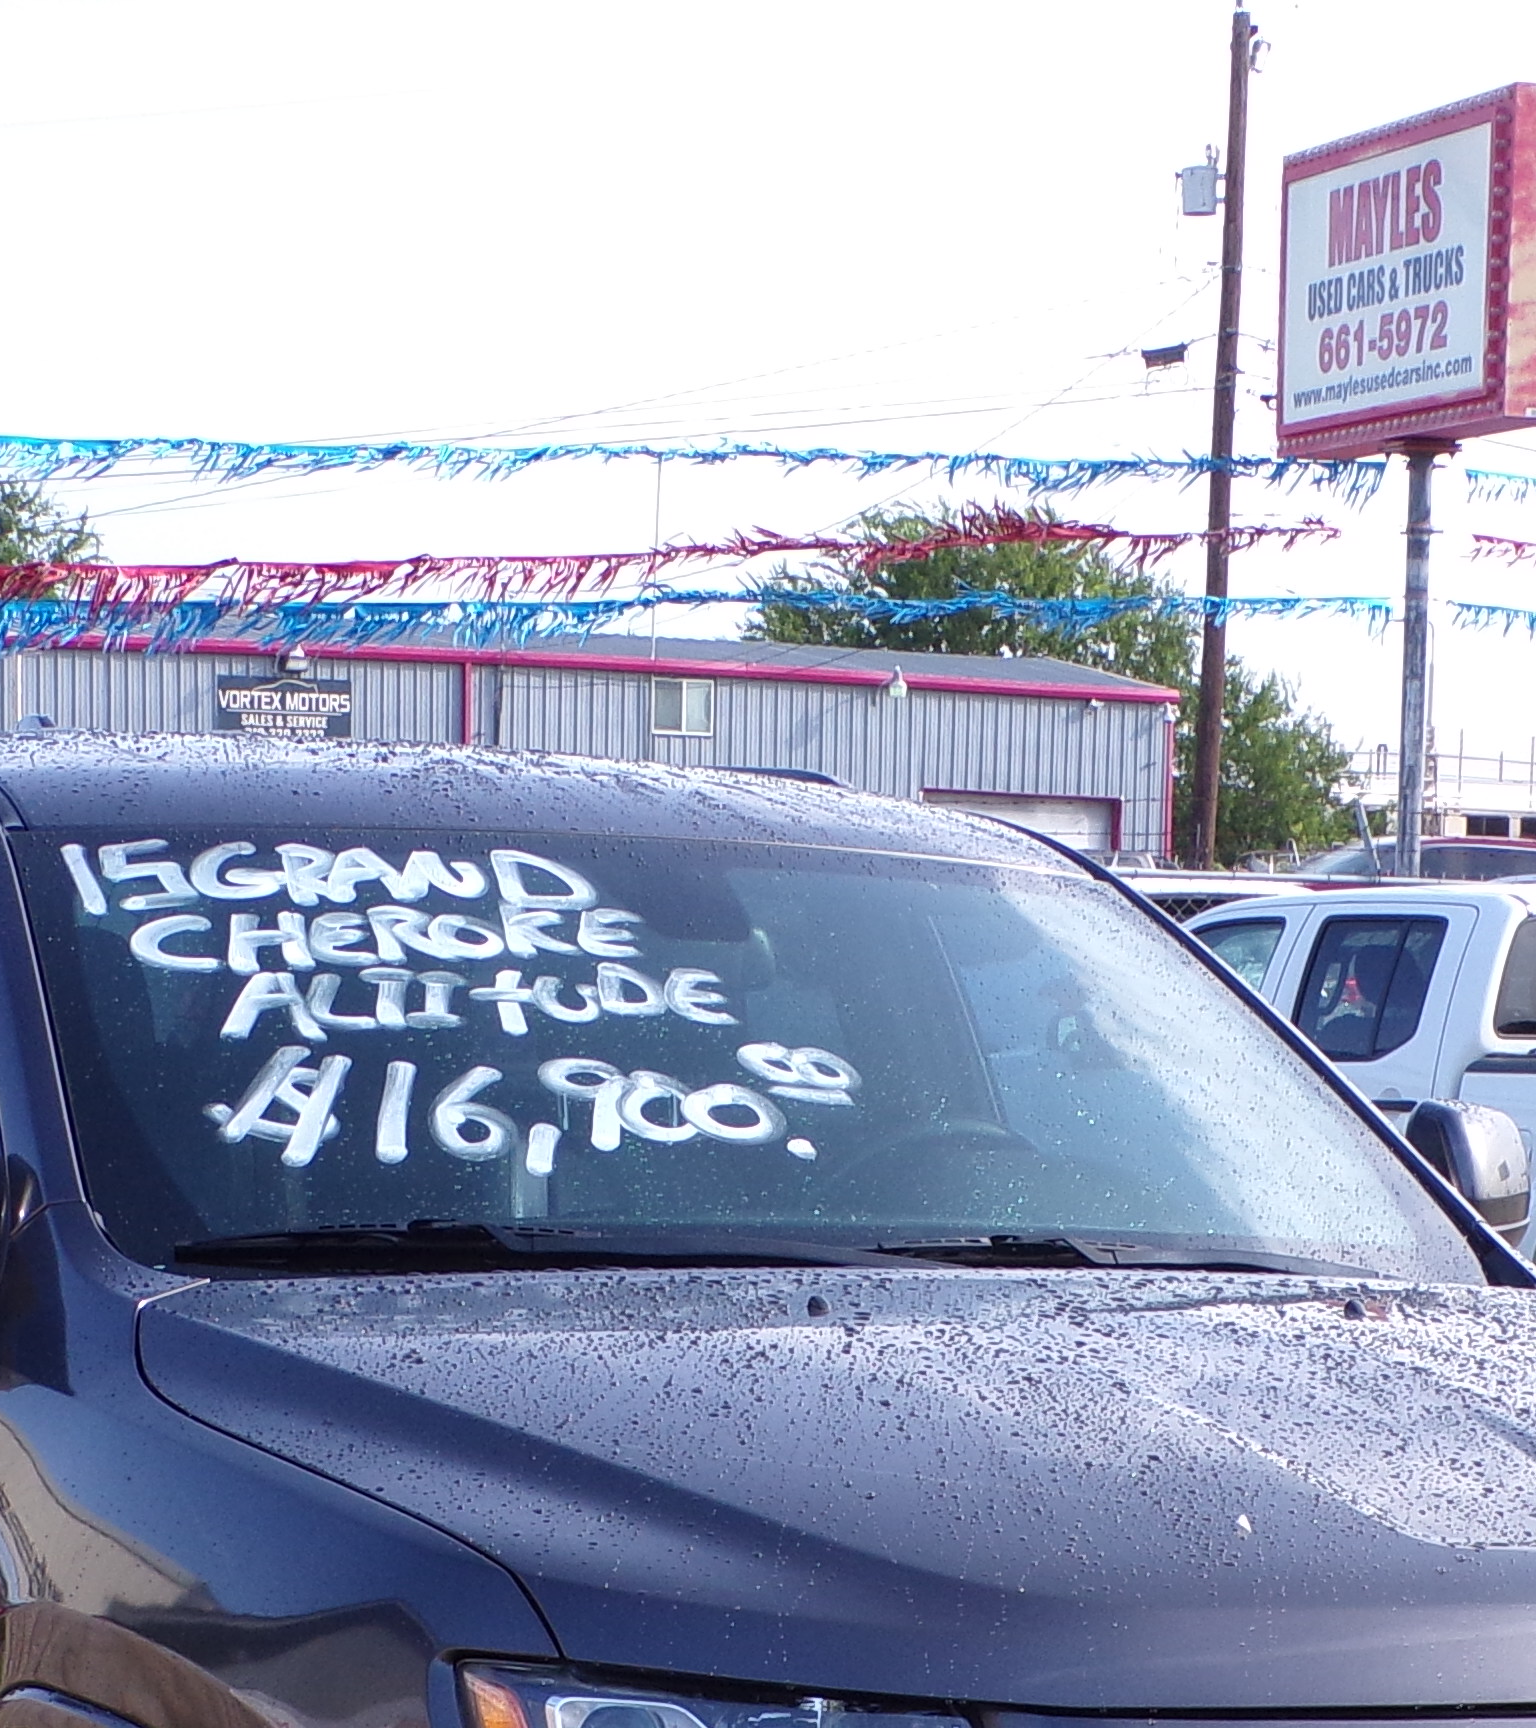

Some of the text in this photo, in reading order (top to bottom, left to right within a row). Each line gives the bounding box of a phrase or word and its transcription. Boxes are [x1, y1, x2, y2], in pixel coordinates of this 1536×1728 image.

[1328, 159, 1442, 269] MAYLES
[1308, 244, 1465, 322] USED CARS & TRUCKS
[1318, 300, 1449, 374] 661-5972
[1293, 354, 1473, 410] www.maylesusedcarsinc.com
[218, 689, 351, 713] VORTEX MOTORS
[241, 713, 328, 729] SALES & SERVICE
